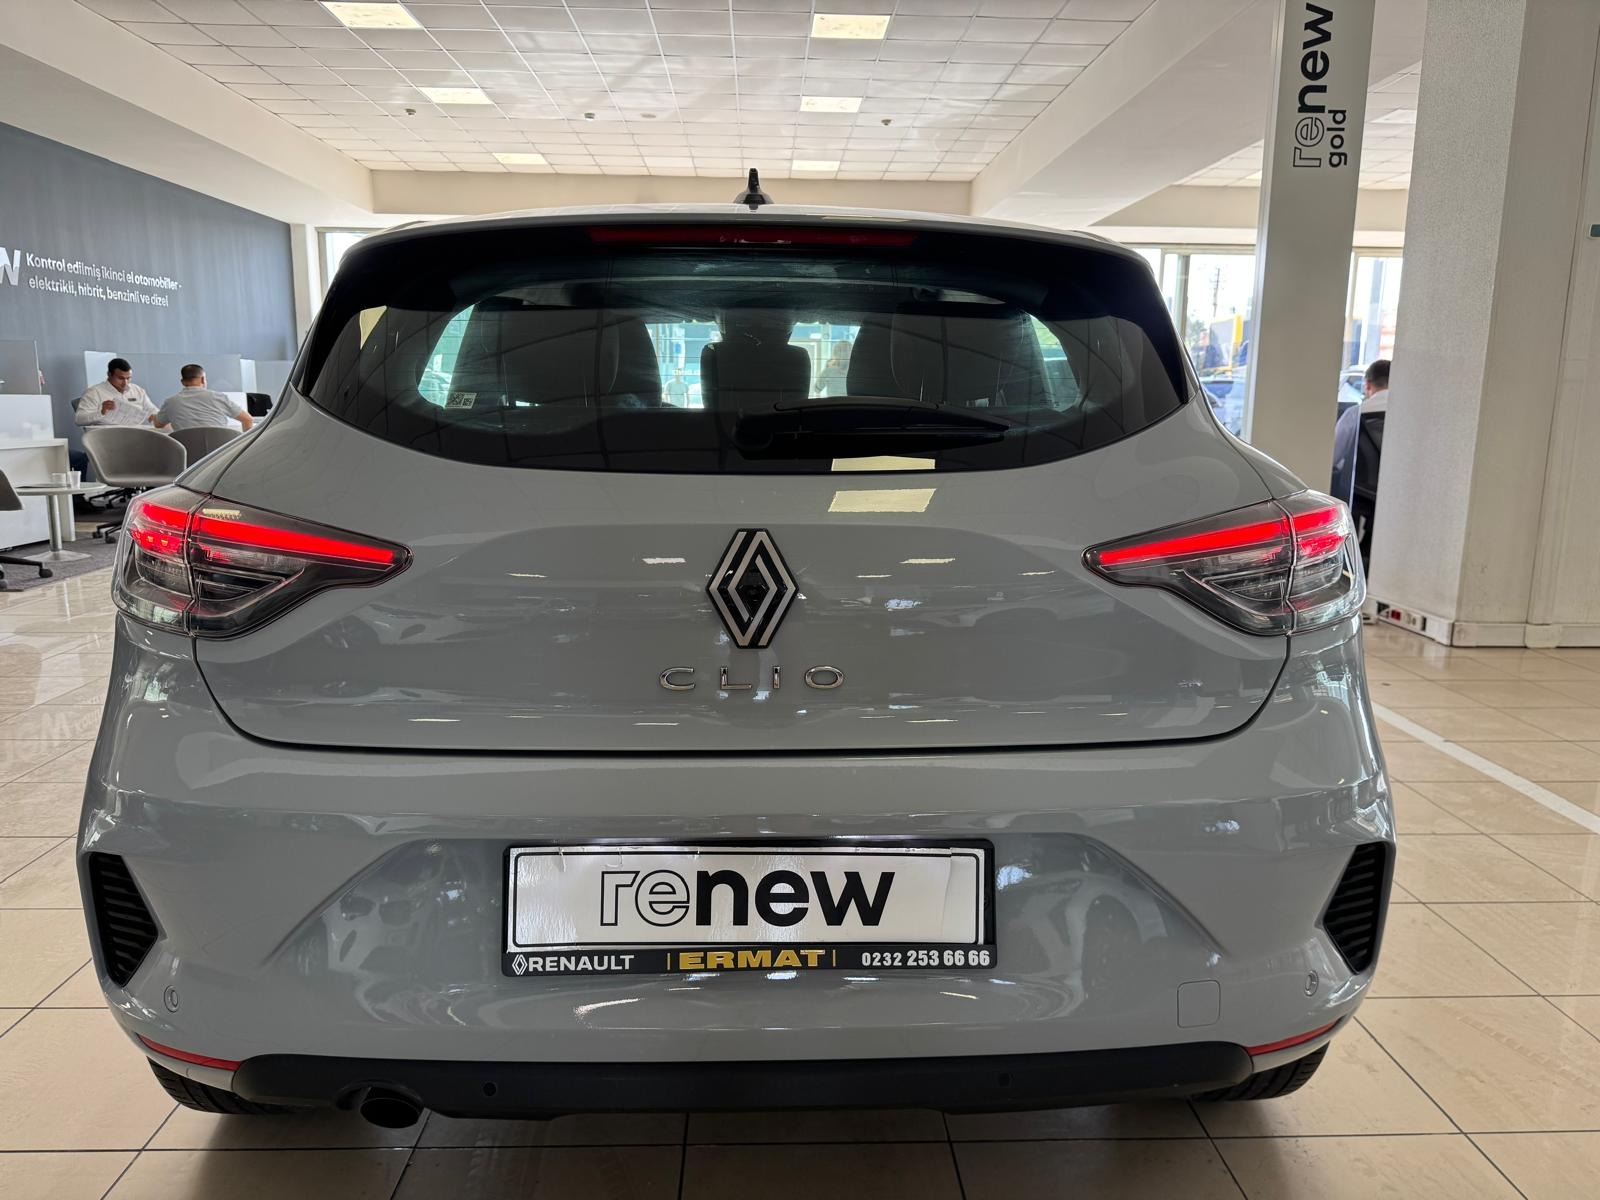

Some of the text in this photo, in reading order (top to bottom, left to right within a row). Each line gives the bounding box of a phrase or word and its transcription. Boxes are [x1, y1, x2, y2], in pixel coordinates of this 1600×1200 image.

[1293, 3, 1333, 168] renew
[1327, 109, 1347, 168] gold
[26, 252, 66, 272] Kontrol
[67, 261, 101, 281] edilmiş
[101, 265, 125, 282] ikinci
[126, 271, 134, 284] el
[28, 275, 169, 308] elektrikli, hibrit, benzinli ve dizel
[659, 665, 844, 691] CLIO
[600, 869, 895, 927] renew
[528, 950, 990, 972] RENAULT ERMAT 0232 253 66 66
